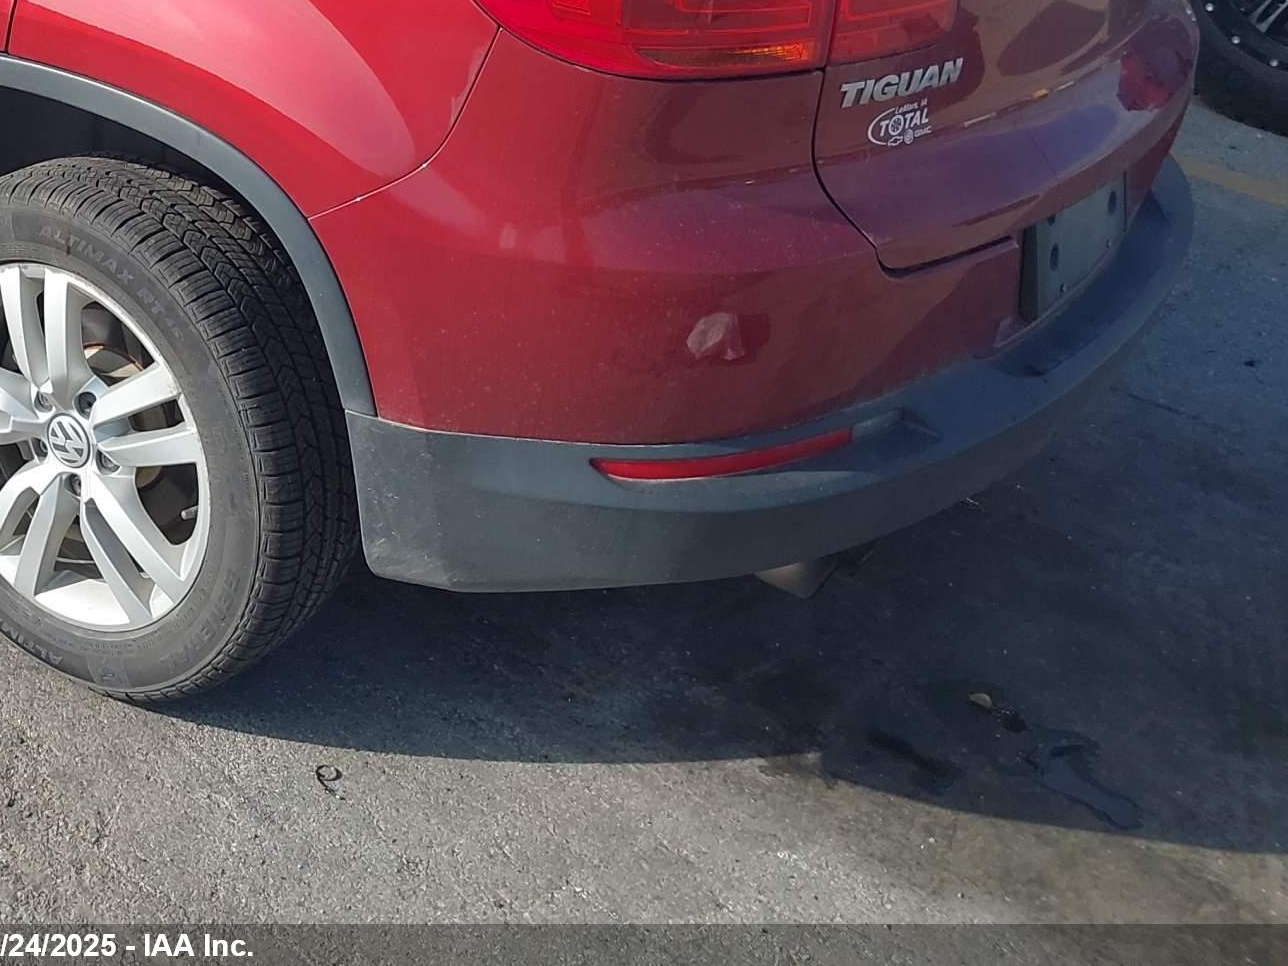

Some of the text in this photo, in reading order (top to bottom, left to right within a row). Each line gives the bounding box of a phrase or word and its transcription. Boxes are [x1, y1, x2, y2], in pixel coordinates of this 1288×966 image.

[840, 58, 963, 109] TIGUAN
[879, 107, 930, 138] TOTAL
[39, 224, 136, 285] ALTIMAX
